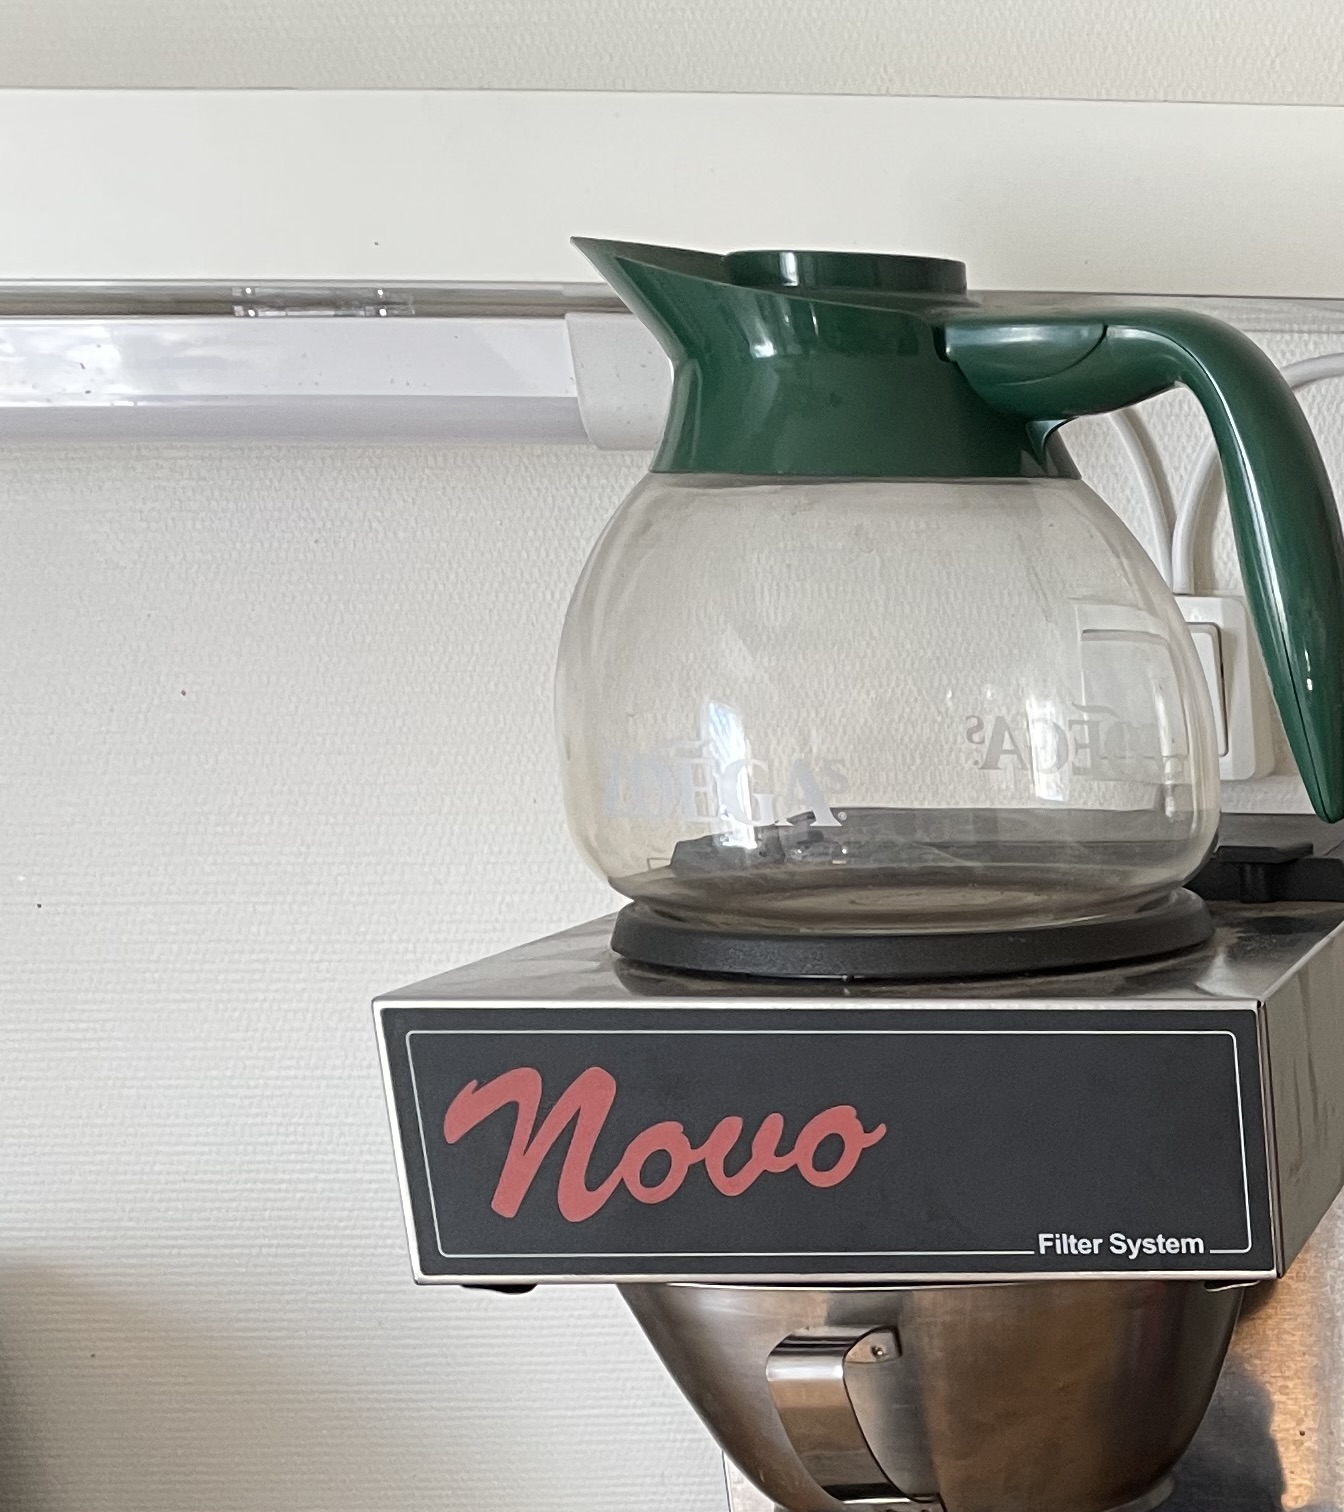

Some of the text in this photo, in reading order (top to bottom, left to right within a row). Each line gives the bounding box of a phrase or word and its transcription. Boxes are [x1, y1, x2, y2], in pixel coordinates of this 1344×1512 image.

[443, 1066, 887, 1222] Novo
[1038, 1231, 1204, 1258] Filter System
